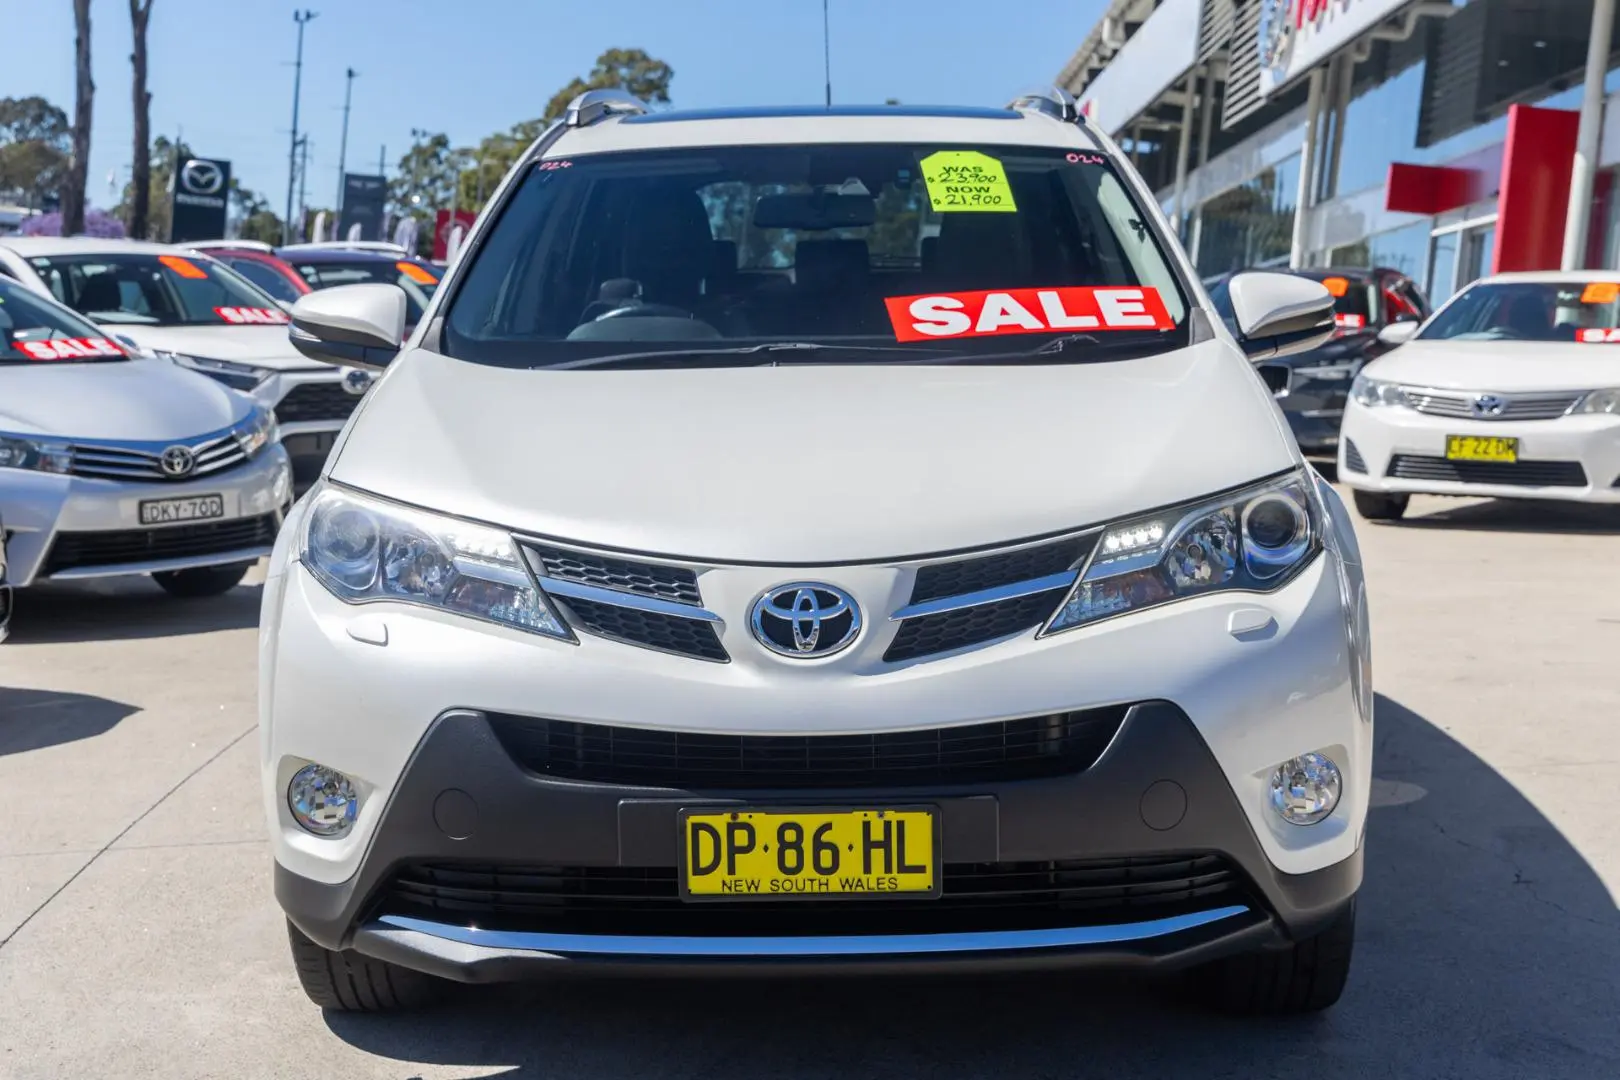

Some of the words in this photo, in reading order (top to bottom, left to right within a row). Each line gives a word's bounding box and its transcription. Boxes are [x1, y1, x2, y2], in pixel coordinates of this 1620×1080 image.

[1066, 153, 1104, 164] 024
[943, 166, 983, 174] WAS
[908, 289, 1156, 336] SALE
[721, 880, 760, 893] NEW
[770, 879, 829, 892] SOUTH
[840, 877, 898, 891] WALES
